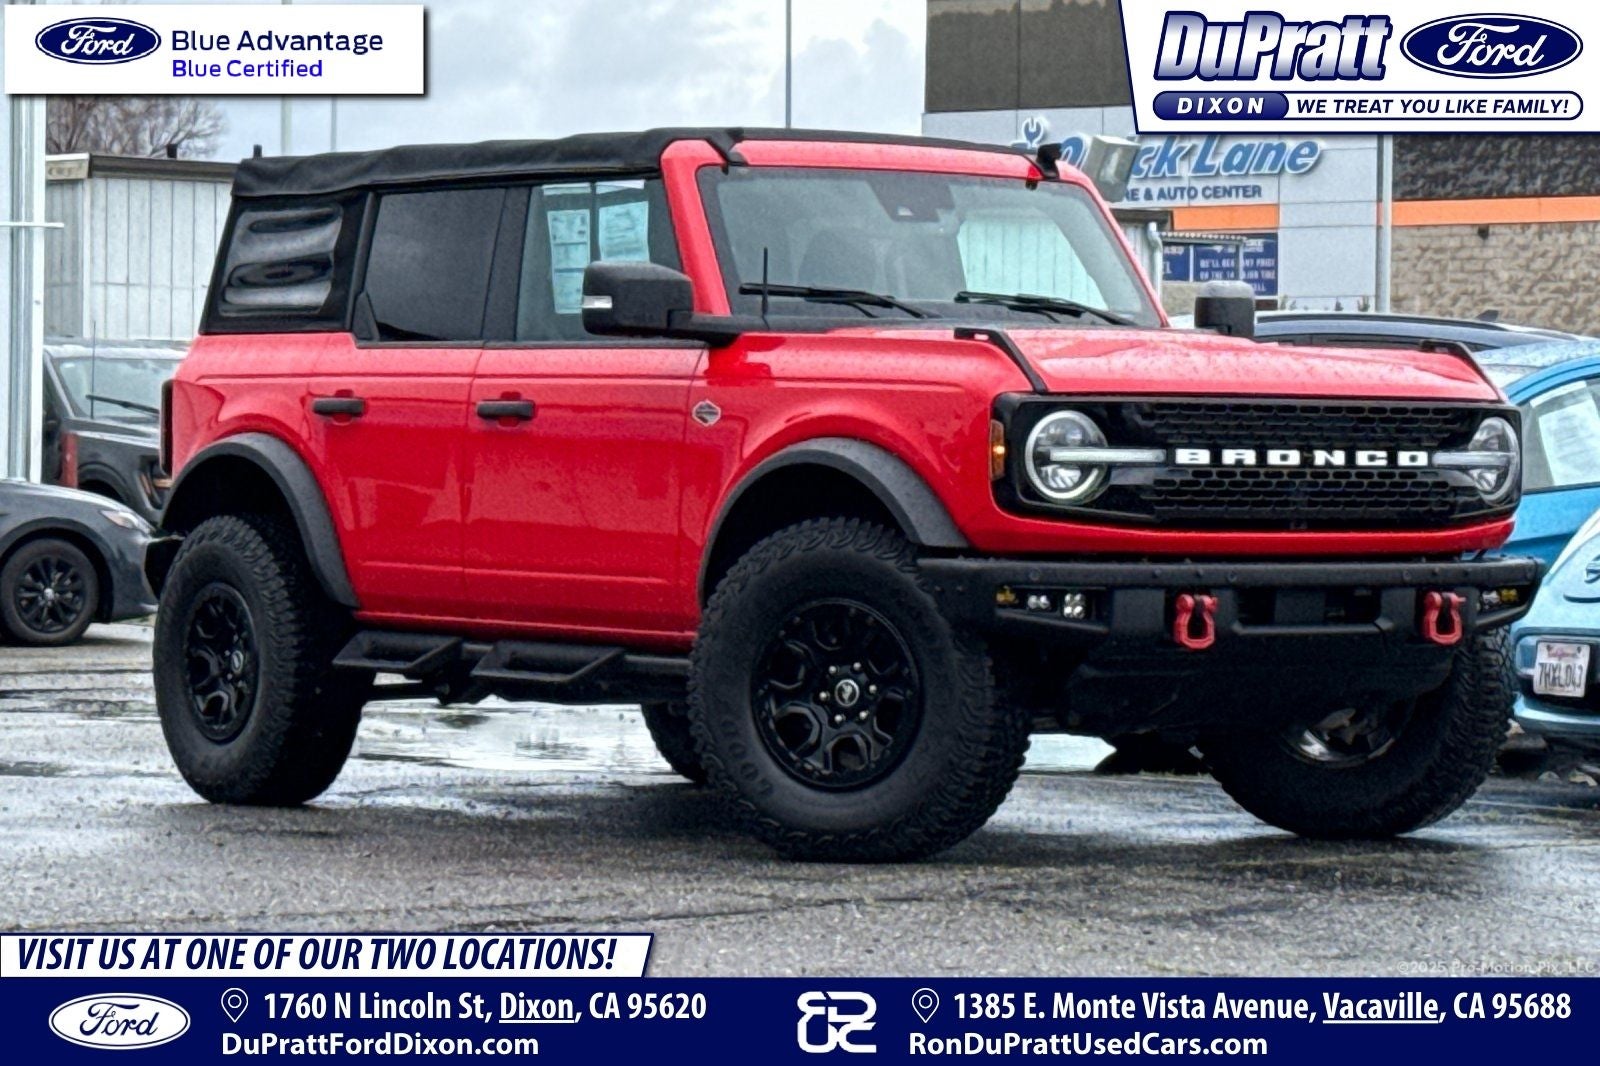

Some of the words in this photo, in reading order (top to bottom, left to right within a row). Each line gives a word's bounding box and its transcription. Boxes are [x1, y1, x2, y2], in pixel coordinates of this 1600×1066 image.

[1189, 134, 1321, 175] Lane
[1143, 189, 1154, 200] &
[1157, 187, 1198, 200] AUTO
[1202, 185, 1262, 199] CENTER
[1175, 448, 1429, 466] BRONCO
